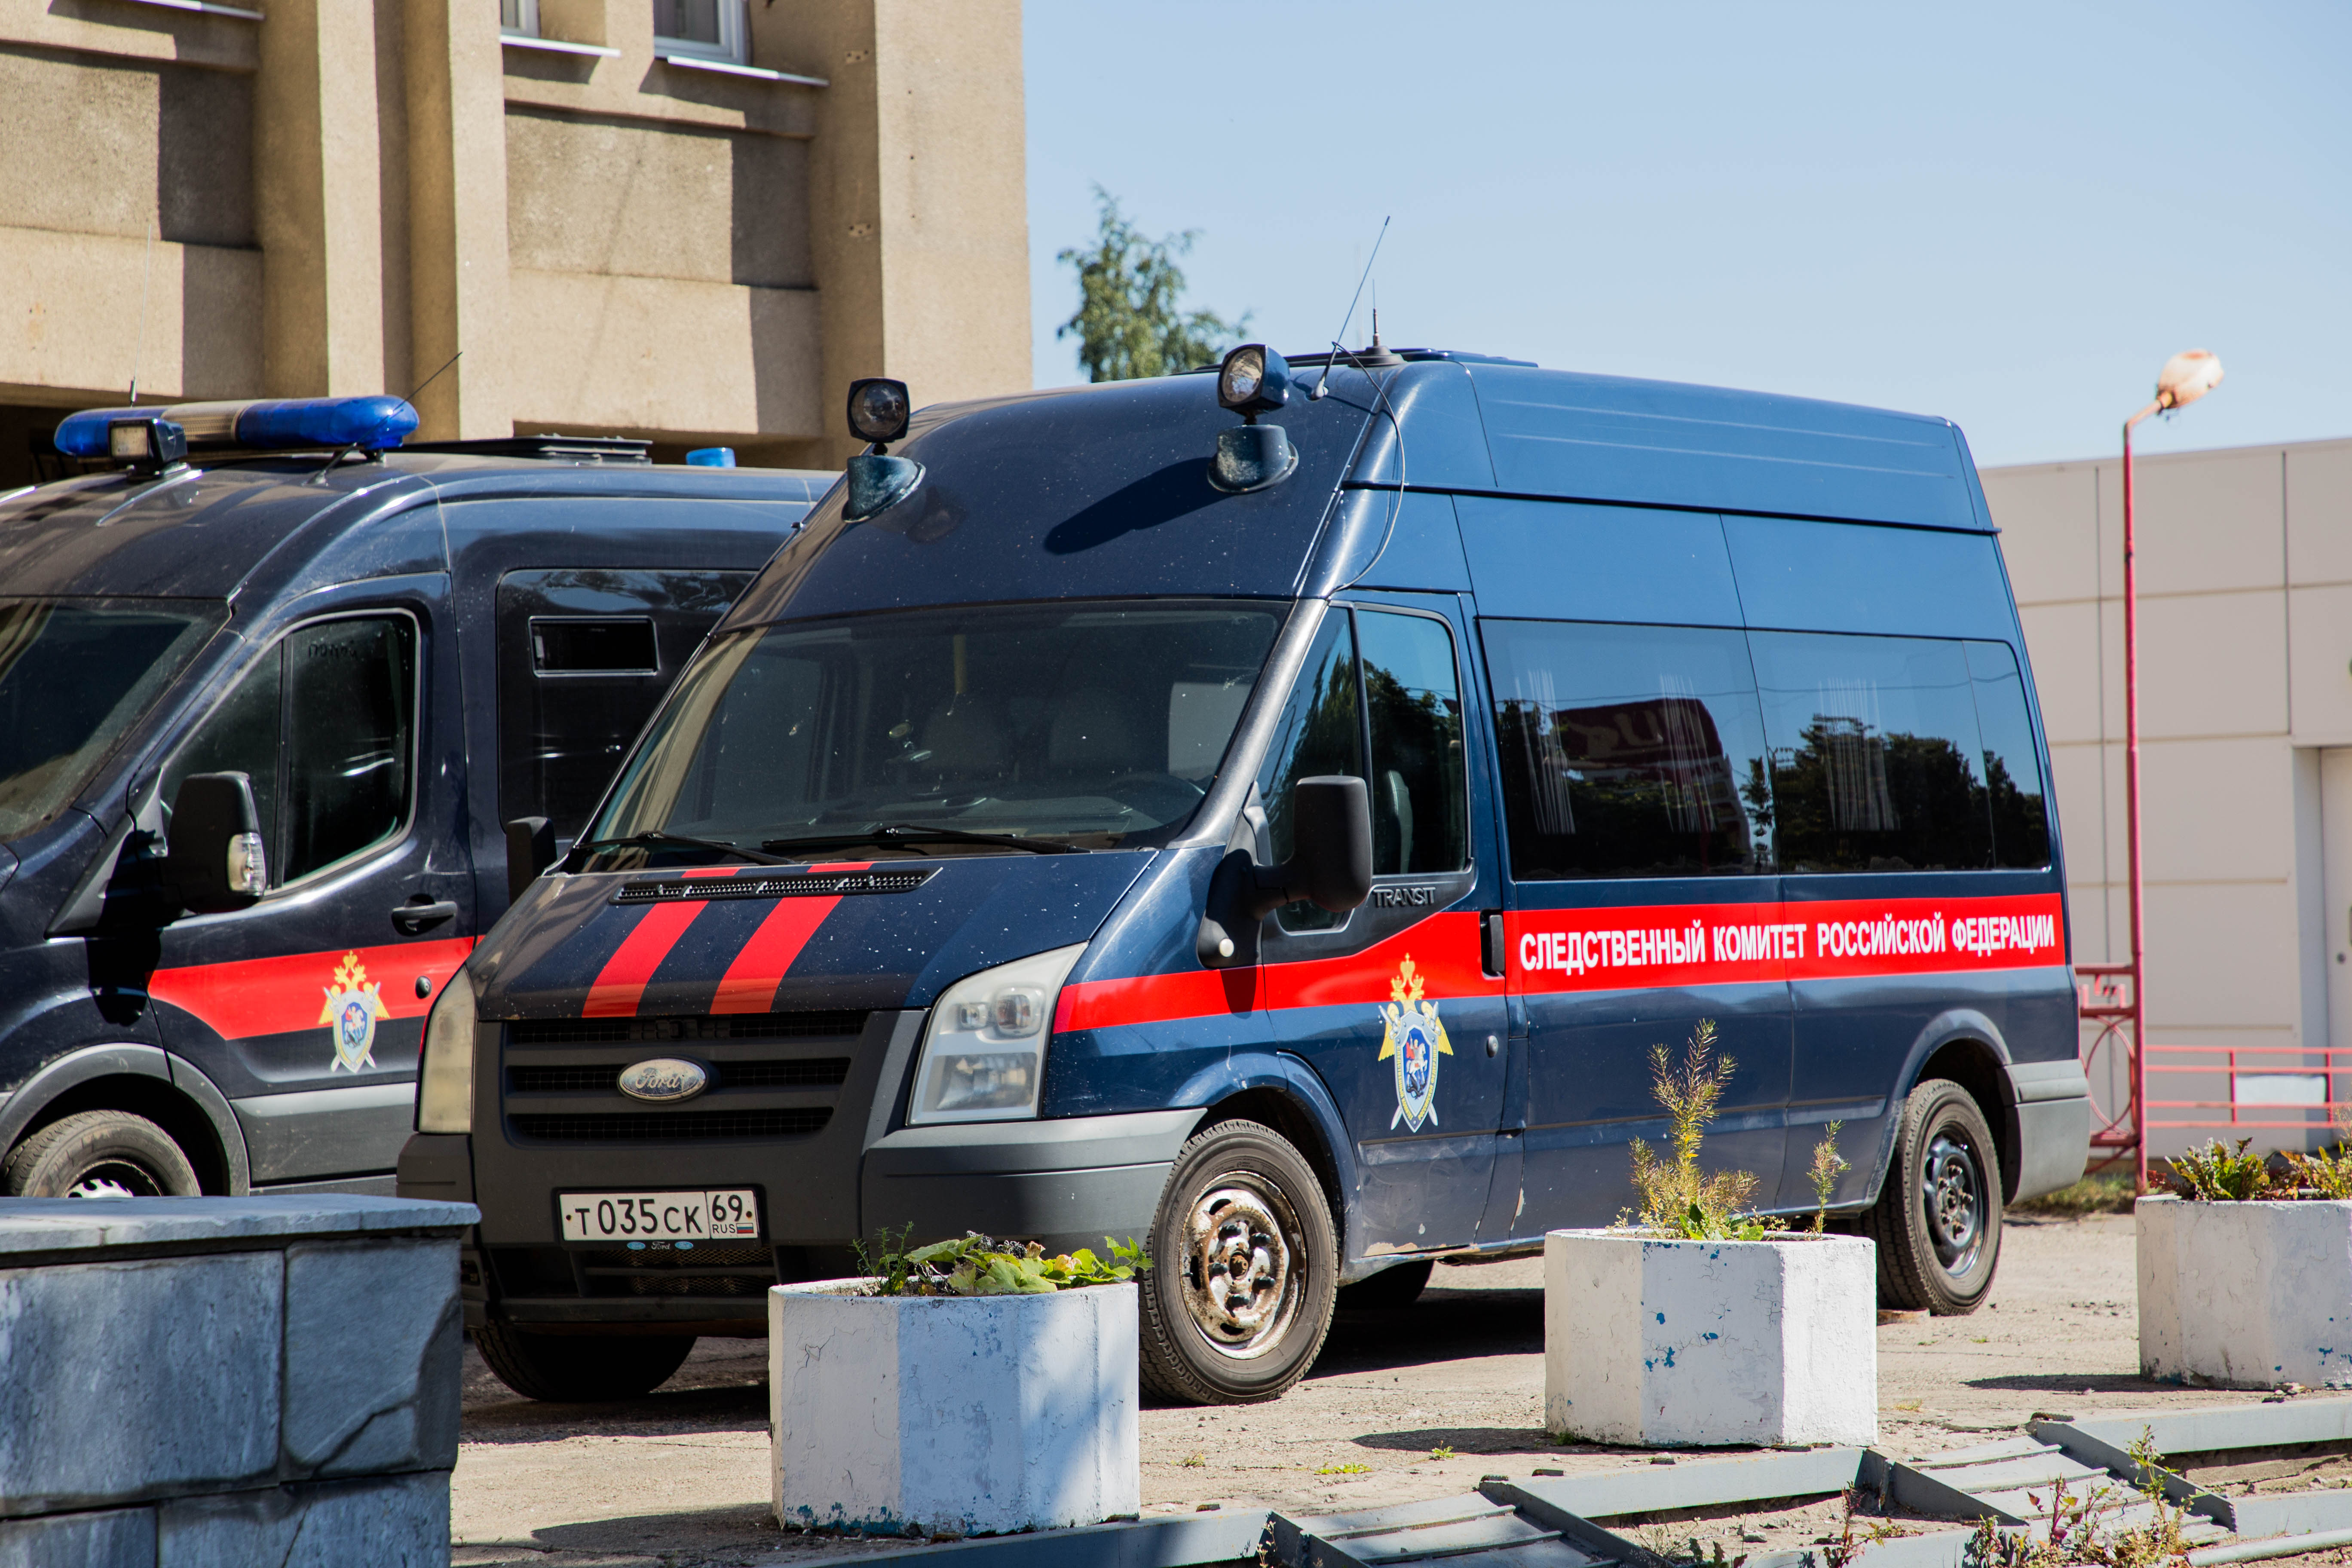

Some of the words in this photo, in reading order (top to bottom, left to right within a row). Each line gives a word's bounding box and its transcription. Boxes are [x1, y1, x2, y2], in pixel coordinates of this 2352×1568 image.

[1373, 887, 1436, 906] TRANSIT
[1520, 919, 1706, 976] СЛЕДСТВЕННЫЙ
[1713, 924, 1807, 962] КОМИТЕТ
[1816, 912, 1946, 957] РОССИЙСКОЙ
[1951, 914, 2055, 957] ФЕДЕРАЦИИ
[635, 1067, 680, 1089] Ford
[575, 1198, 703, 1235] Т035СК
[712, 1194, 743, 1222] 69
[713, 1224, 736, 1234] RUS
[651, 1241, 671, 1250] Ford
[1313, 1260, 1329, 1329] TOYO
